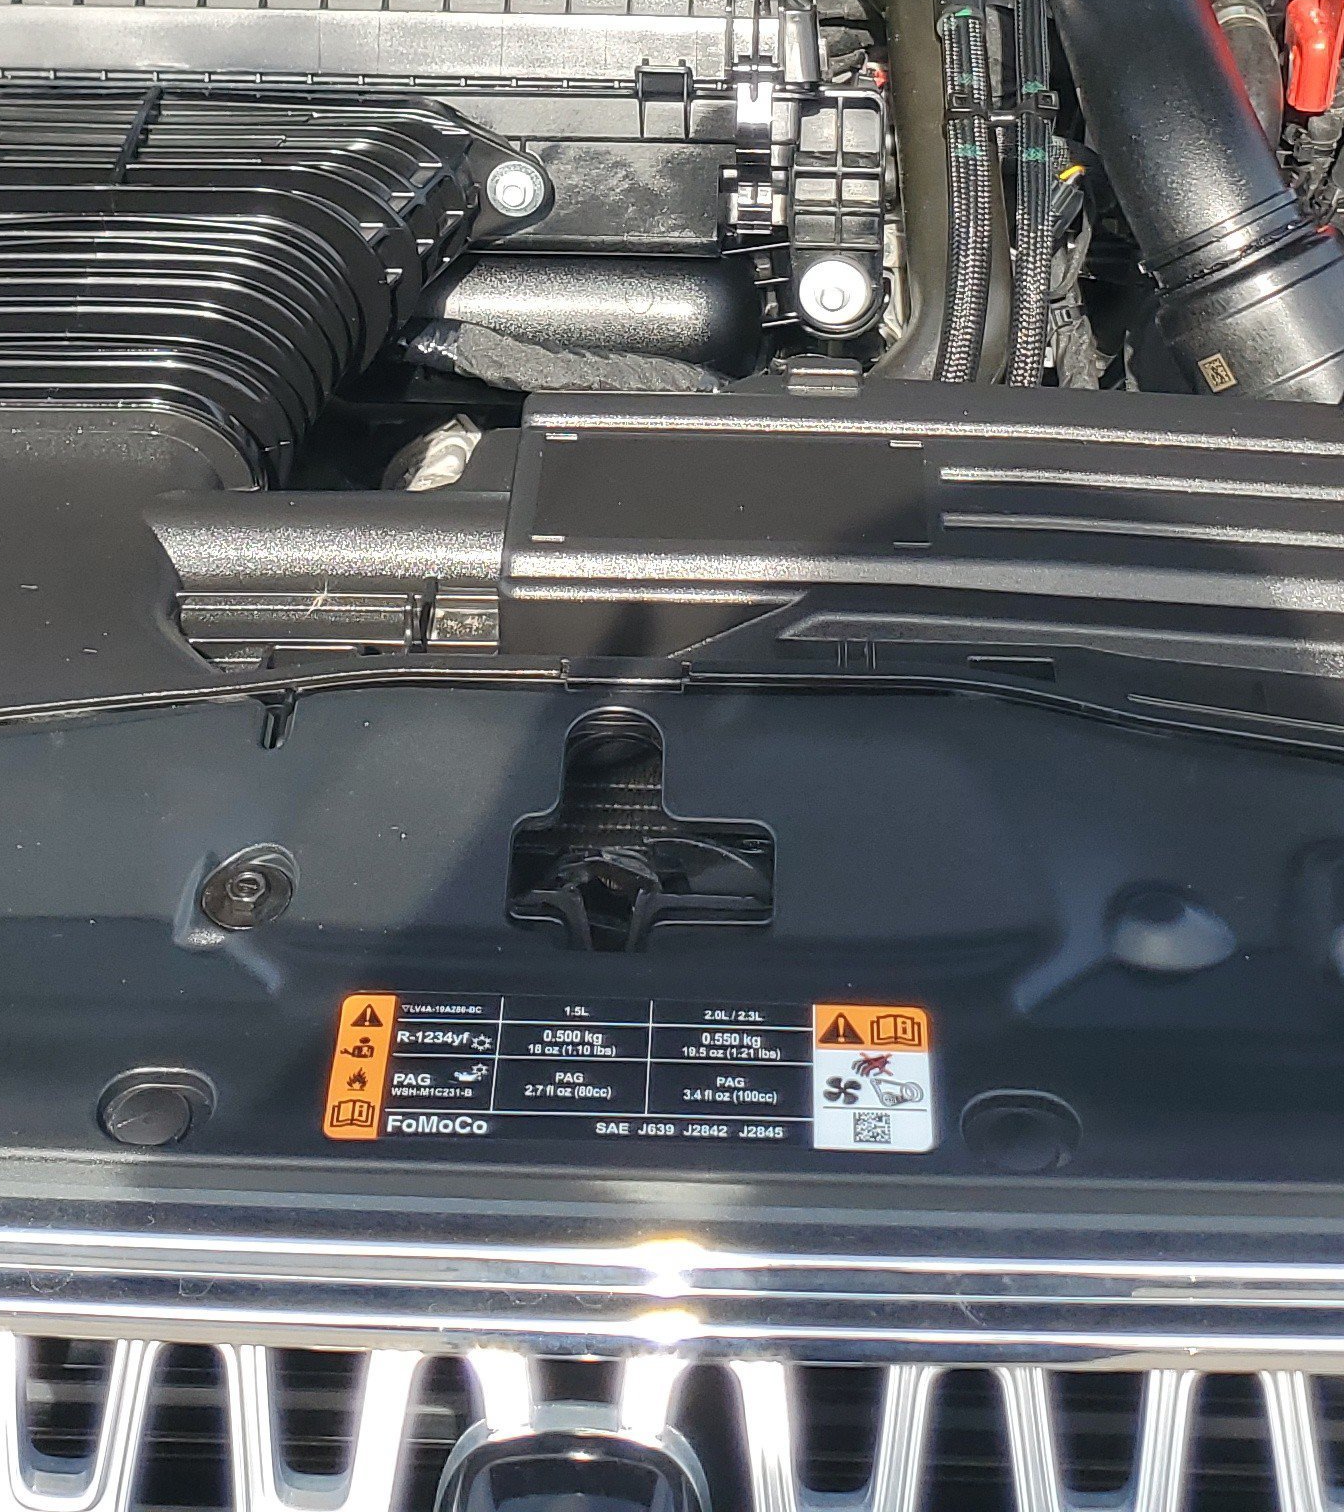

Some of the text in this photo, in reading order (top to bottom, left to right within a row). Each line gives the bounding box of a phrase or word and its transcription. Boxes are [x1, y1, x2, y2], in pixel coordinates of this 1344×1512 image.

[563, 1005, 590, 1017] 1.5L
[704, 1010, 729, 1020] 2.0L
[737, 1010, 764, 1021] 2.3L
[396, 1030, 471, 1046] R-1234yf
[542, 1029, 603, 1045] 0.500 kg
[701, 1032, 761, 1048] 0.550 kg
[544, 1046, 560, 1055] oz
[593, 1045, 617, 1058] lbs)
[709, 1048, 724, 1057] oz
[758, 1048, 781, 1061] lbs)
[392, 1073, 431, 1086] PAG
[555, 1072, 584, 1084] PAG
[716, 1076, 745, 1088] PAG
[391, 1087, 473, 1098] WSH-M1C231-B
[524, 1084, 612, 1100] 2.7 fl oz (80cc)
[683, 1088, 777, 1105] 3.4 fl oz (100cc)
[386, 1115, 488, 1134] FoMoCo
[595, 1122, 784, 1138] SAE J639 J2842 J2845
